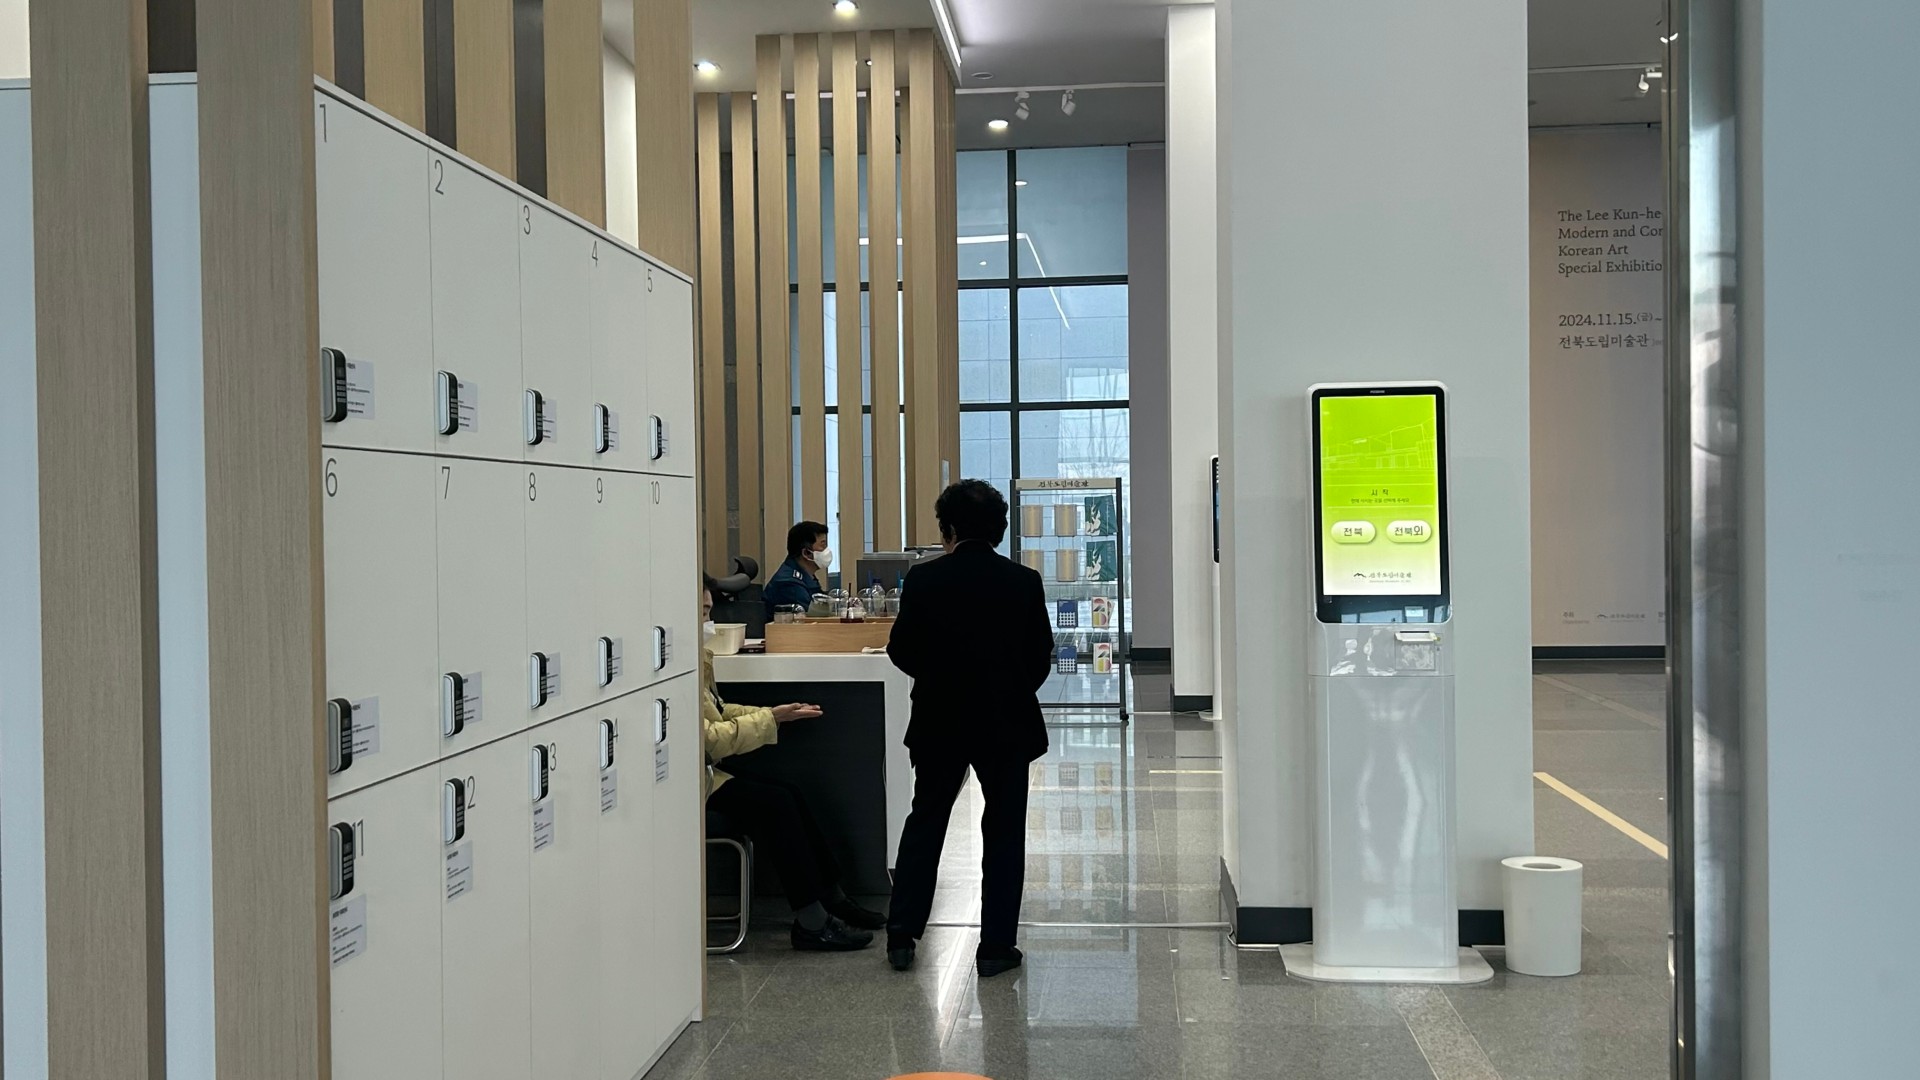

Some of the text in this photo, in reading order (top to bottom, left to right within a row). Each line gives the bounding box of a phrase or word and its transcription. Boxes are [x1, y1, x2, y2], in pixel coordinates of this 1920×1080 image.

[319, 103, 327, 143] 1
[434, 159, 444, 195] 2
[523, 204, 532, 235] 3
[1557, 206, 1662, 222] The Lee Kun-he
[1558, 226, 1609, 239] Modern
[1612, 225, 1636, 238] and
[591, 240, 599, 267] 4
[1558, 243, 1629, 257] Korean Art
[647, 268, 653, 293] 5
[1558, 259, 1663, 277] Special Exhibitio
[1559, 332, 1650, 349] 전북도립미술관
[325, 457, 338, 498] 6
[441, 465, 451, 500] 7
[528, 471, 537, 502] 8
[596, 476, 604, 505] 9
[651, 480, 661, 506] 10
[1343, 527, 1363, 537] 전북
[546, 742, 557, 772] 3
[462, 775, 476, 810] 2
